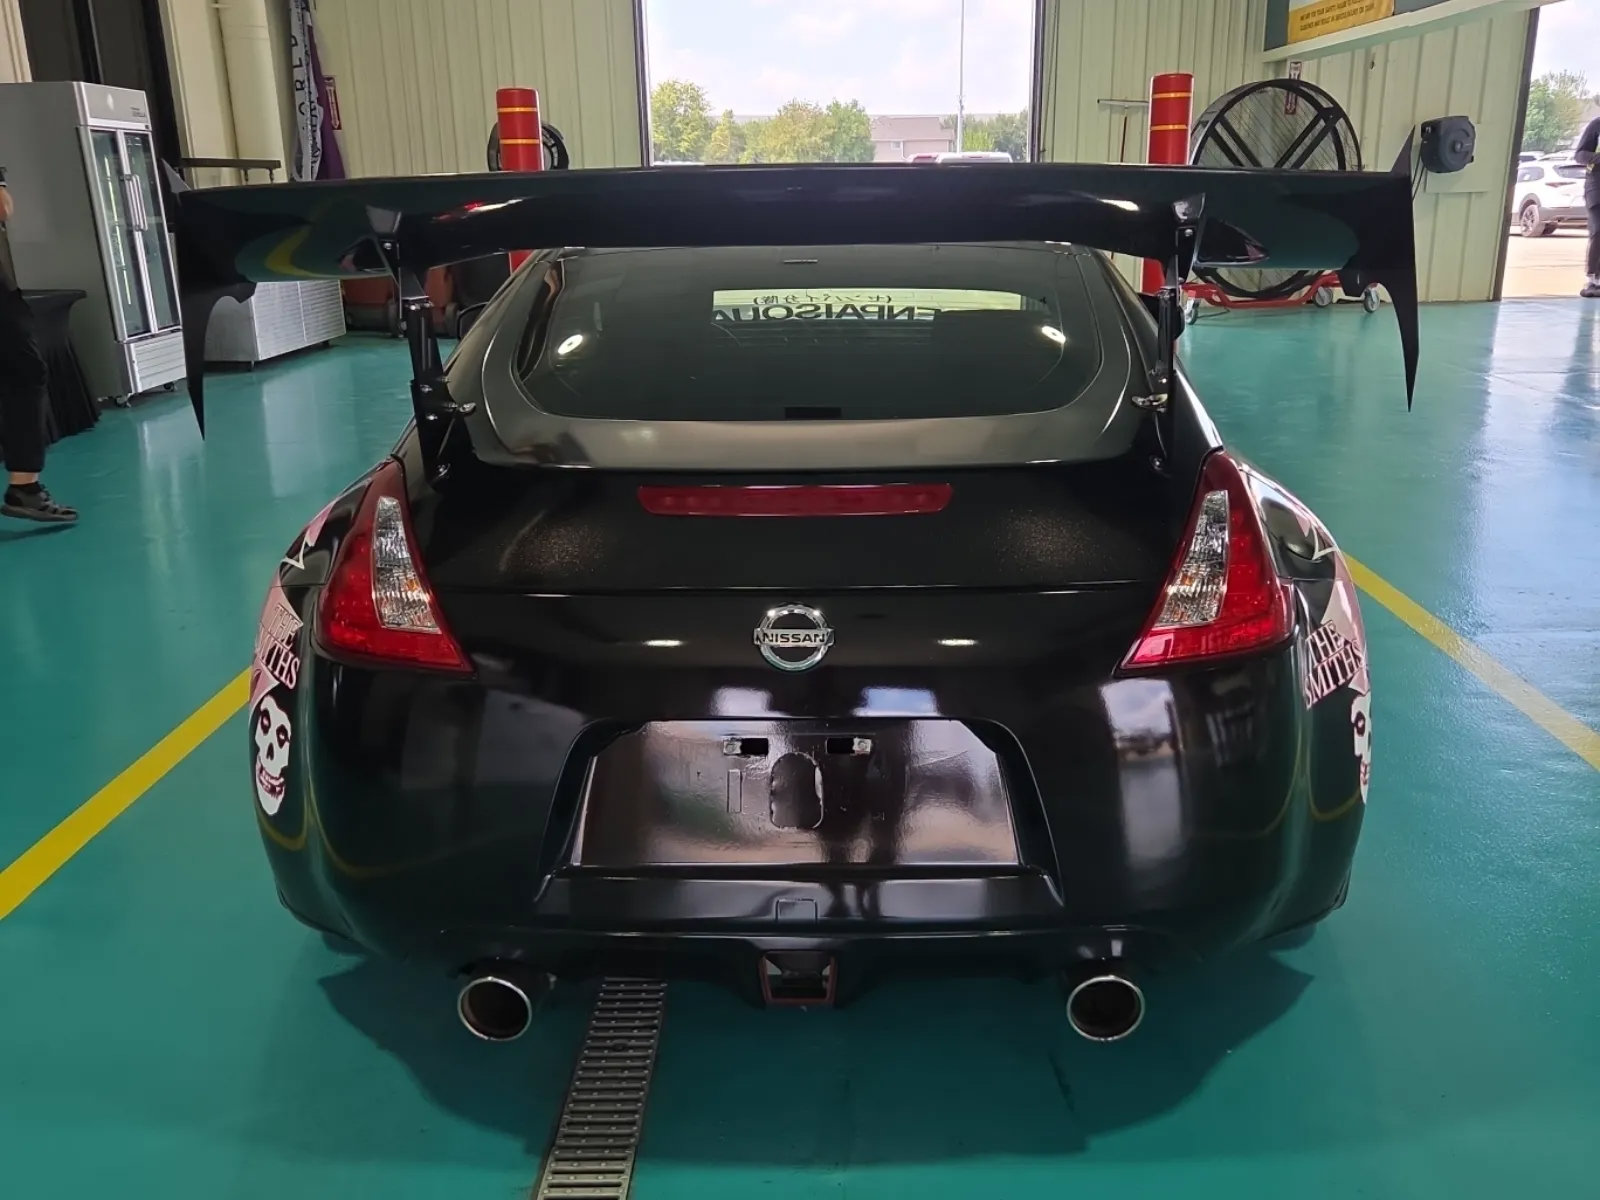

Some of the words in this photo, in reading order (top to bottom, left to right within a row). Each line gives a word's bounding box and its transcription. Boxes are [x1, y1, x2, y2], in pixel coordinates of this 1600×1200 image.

[290, 33, 306, 118] ORLD
[267, 603, 299, 650] THE
[762, 633, 825, 643] NISSAN
[1305, 620, 1345, 668] THE
[254, 624, 300, 690] MITHS
[1304, 640, 1364, 710] SMITHS
